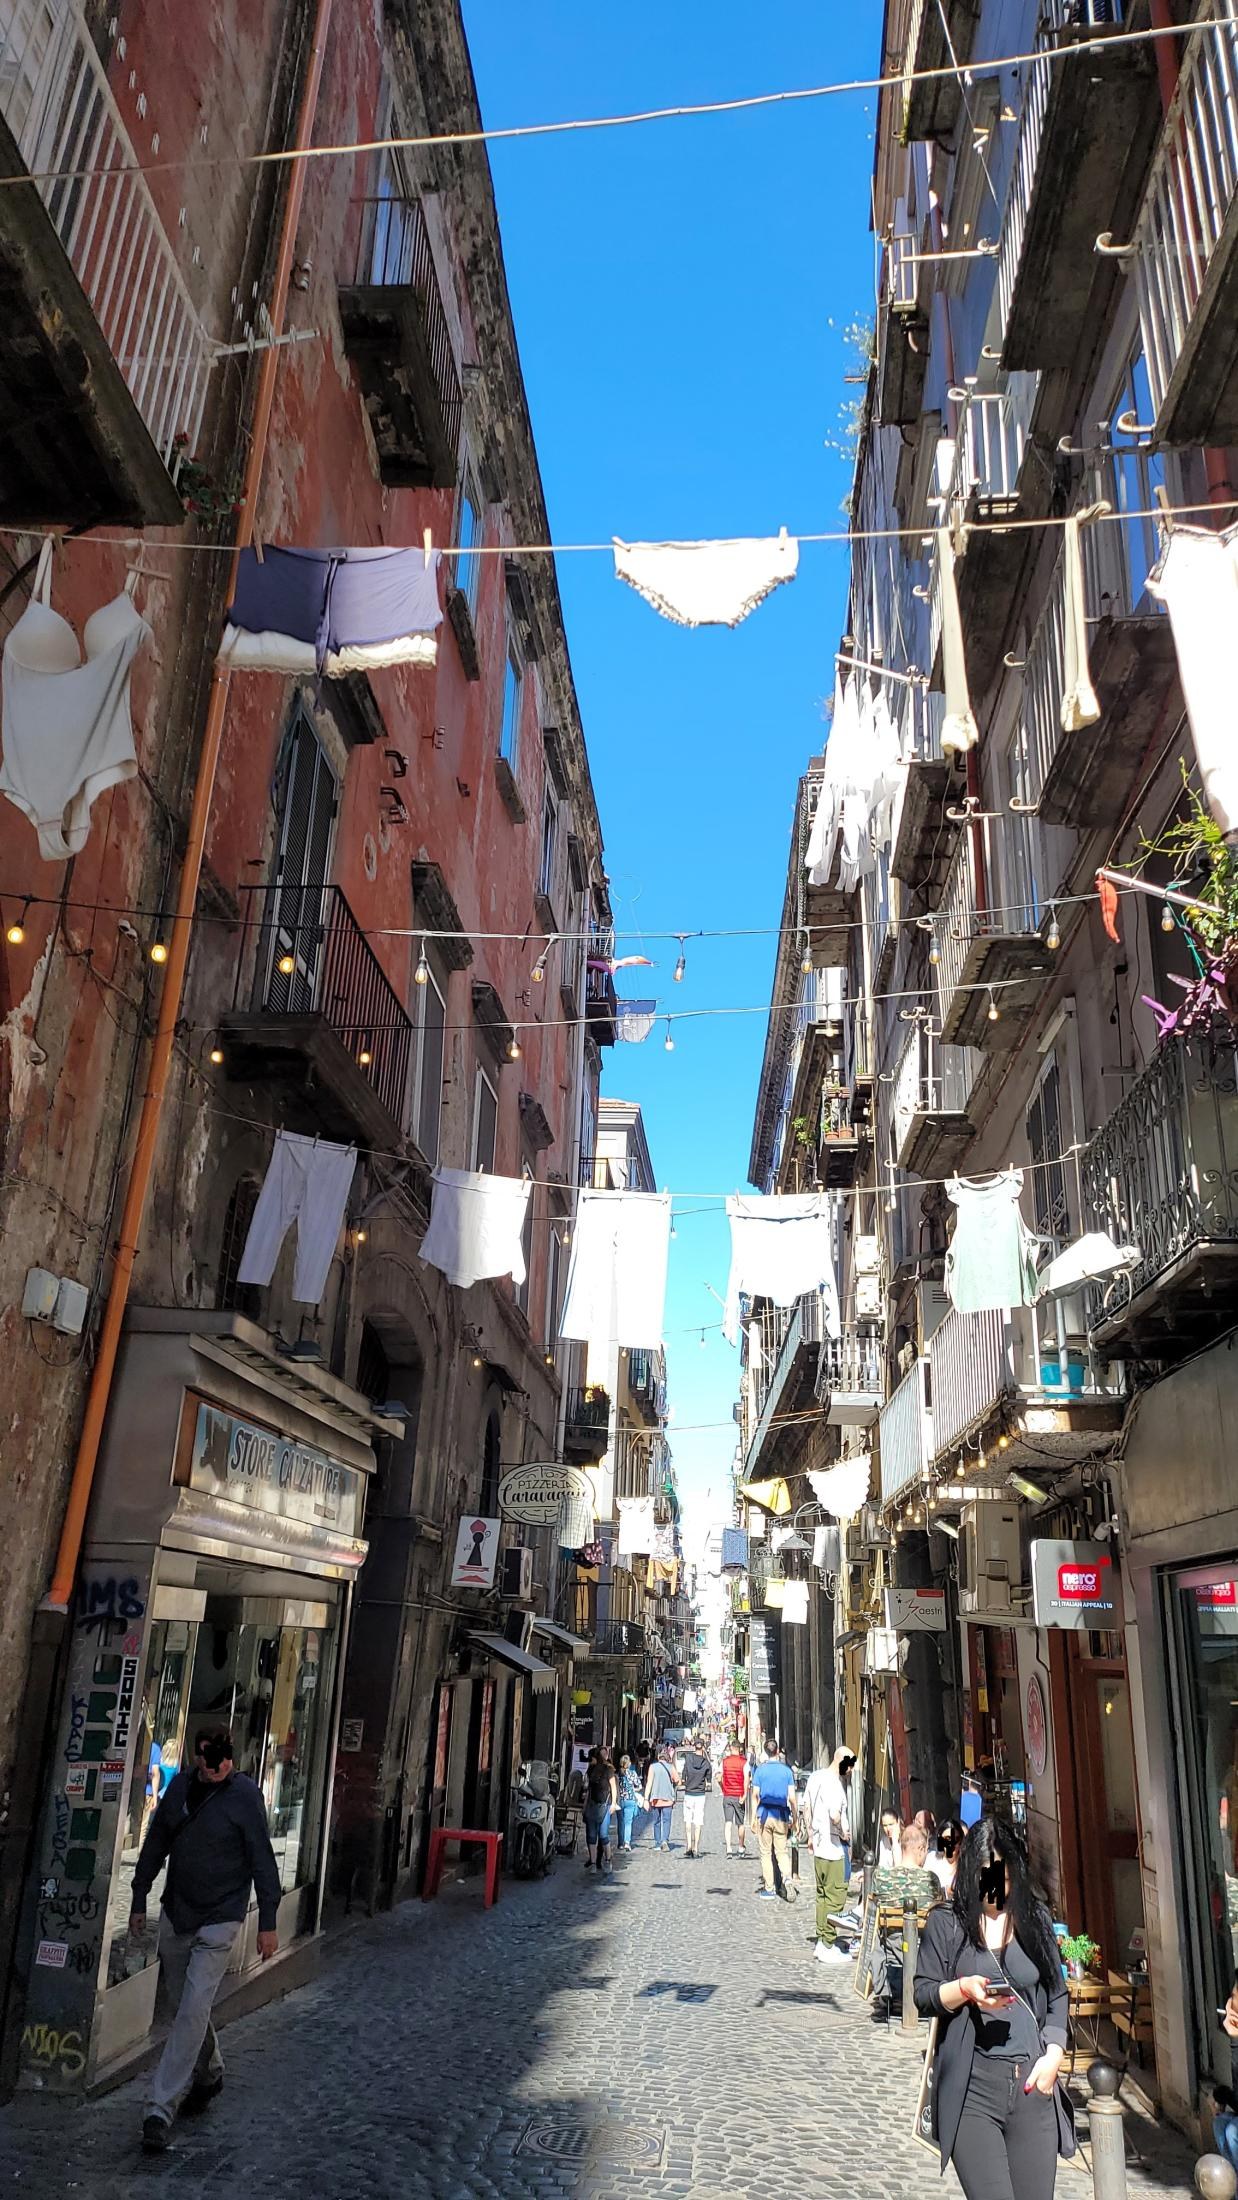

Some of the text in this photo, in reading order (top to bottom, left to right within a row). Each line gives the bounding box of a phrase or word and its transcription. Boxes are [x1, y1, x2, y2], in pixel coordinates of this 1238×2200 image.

[231, 1427, 276, 1482] STORE
[518, 1480, 574, 1489] PIZZERIA
[1062, 1572, 1097, 1585] nero
[1063, 1584, 1097, 1592] espresso
[1061, 1600, 1082, 1608] ITALIAN
[1083, 1601, 1104, 1609] APPEAL
[114, 1660, 138, 1748] SONIC
